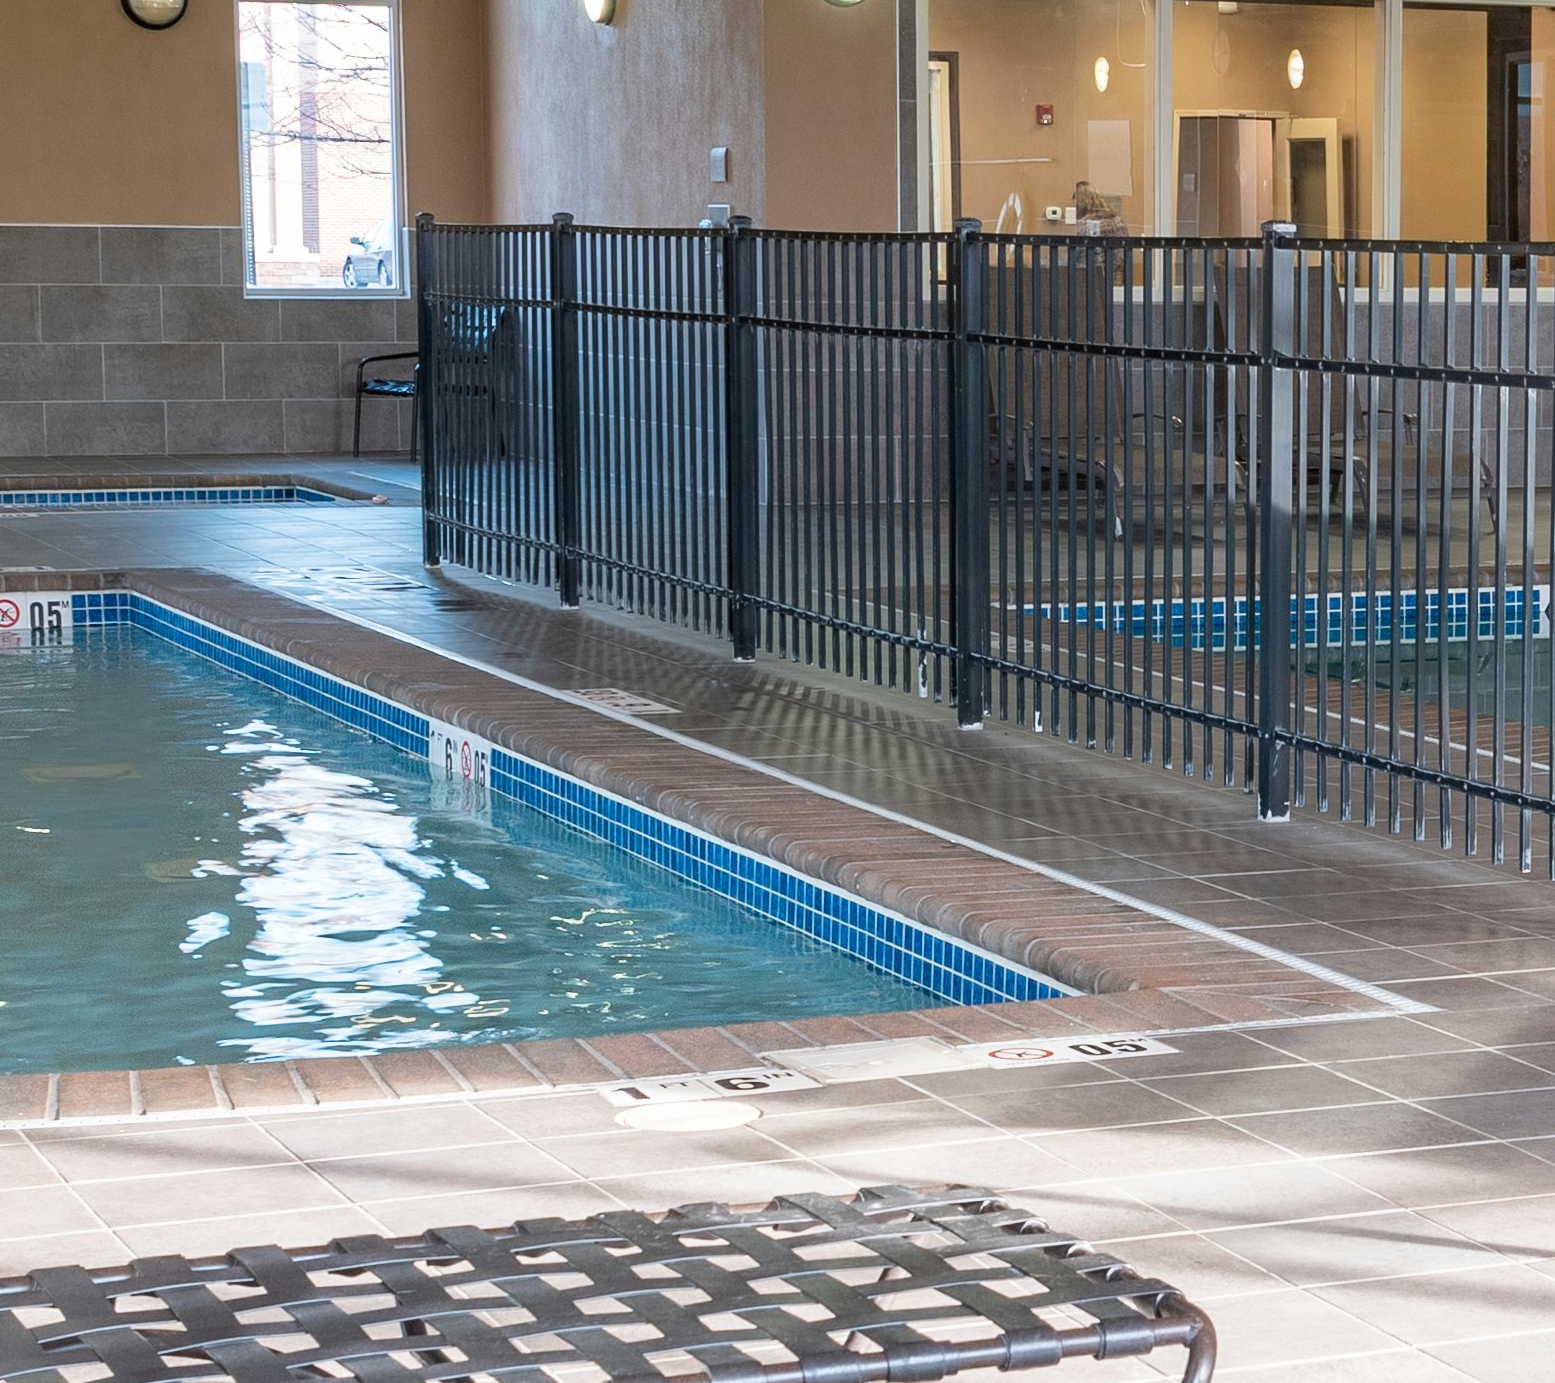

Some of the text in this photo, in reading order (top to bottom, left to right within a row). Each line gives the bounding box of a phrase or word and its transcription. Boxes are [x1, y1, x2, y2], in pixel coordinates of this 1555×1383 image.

[612, 1072, 795, 1100] 1 FT 6 IN
